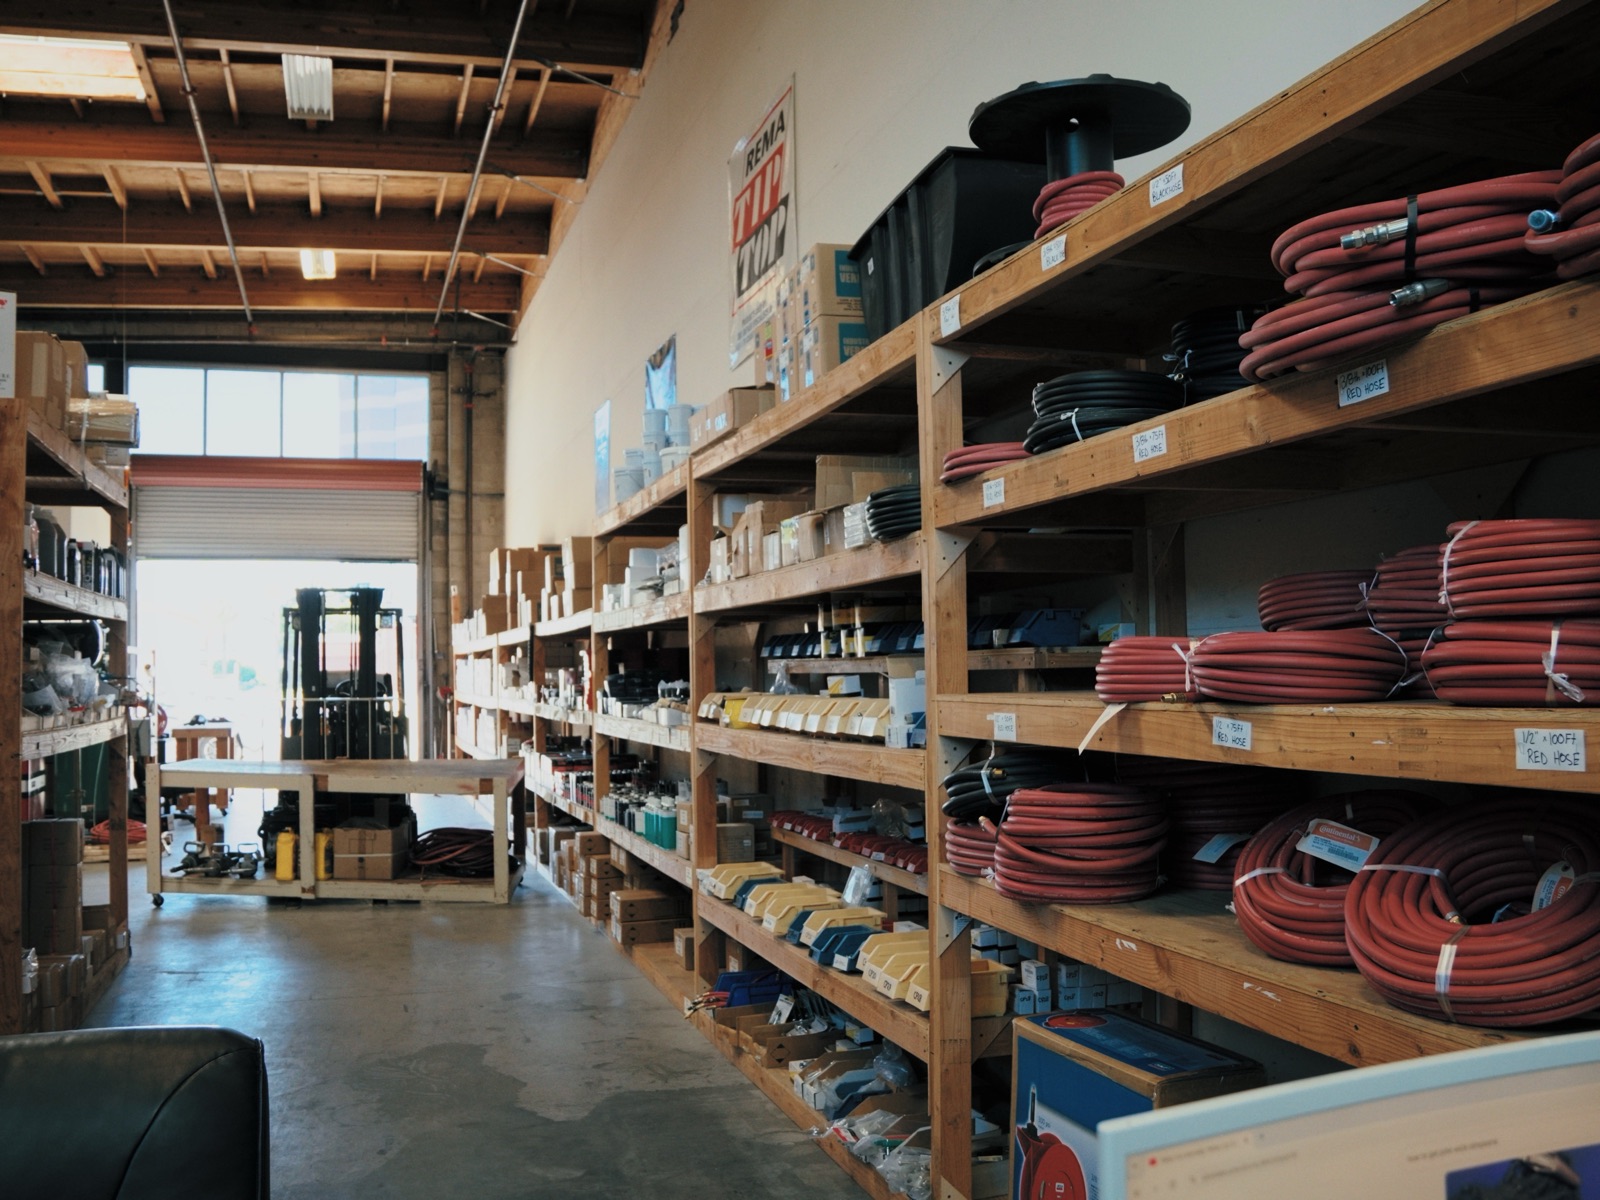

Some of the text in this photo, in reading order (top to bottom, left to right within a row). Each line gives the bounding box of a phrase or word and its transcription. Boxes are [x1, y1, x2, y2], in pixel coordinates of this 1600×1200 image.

[745, 109, 786, 177] REMA
[733, 149, 784, 244] TIP
[738, 204, 789, 295] TOP
[1346, 377, 1385, 400] RED HOSE
[1138, 442, 1164, 459] RED HOSE
[1217, 731, 1247, 747] RED HOSE
[1526, 748, 1581, 767] RED HOSE
[1319, 824, 1356, 841] Continental
